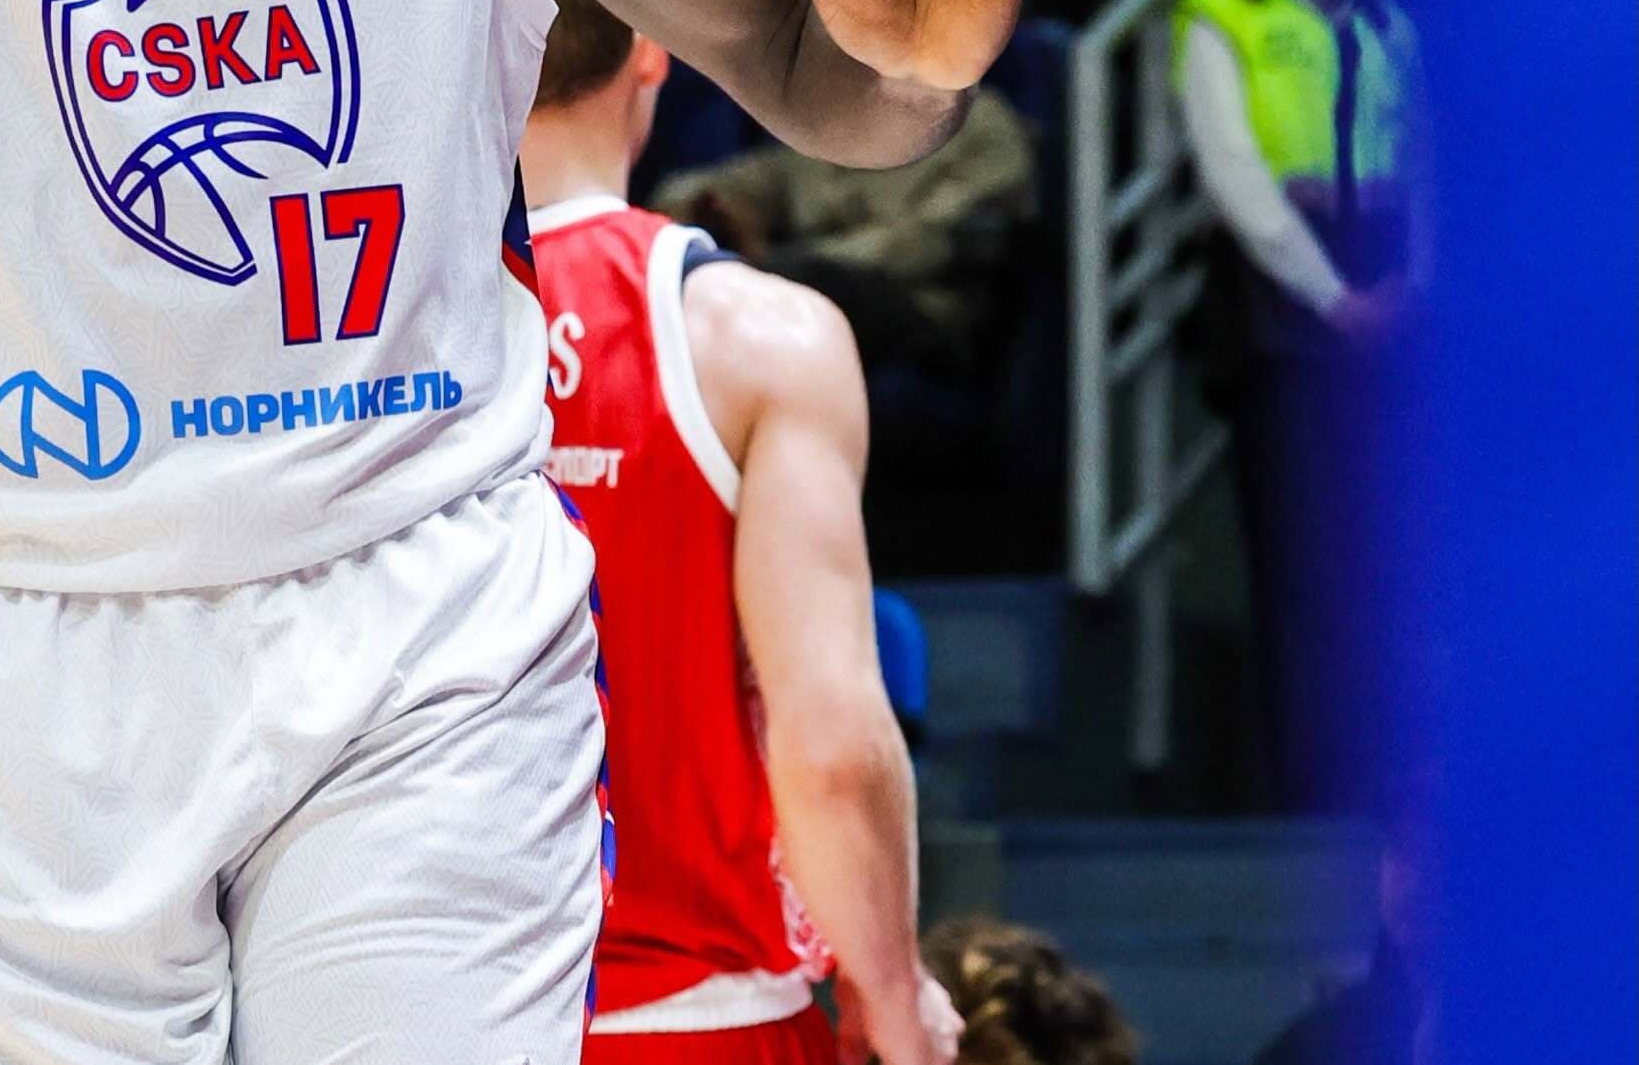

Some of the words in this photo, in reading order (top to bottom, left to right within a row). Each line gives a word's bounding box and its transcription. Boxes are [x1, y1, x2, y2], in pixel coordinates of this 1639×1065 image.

[86, 4, 322, 102] CSKA
[269, 183, 405, 346] 17
[172, 370, 463, 439] НОРНИКЕЛЬ
